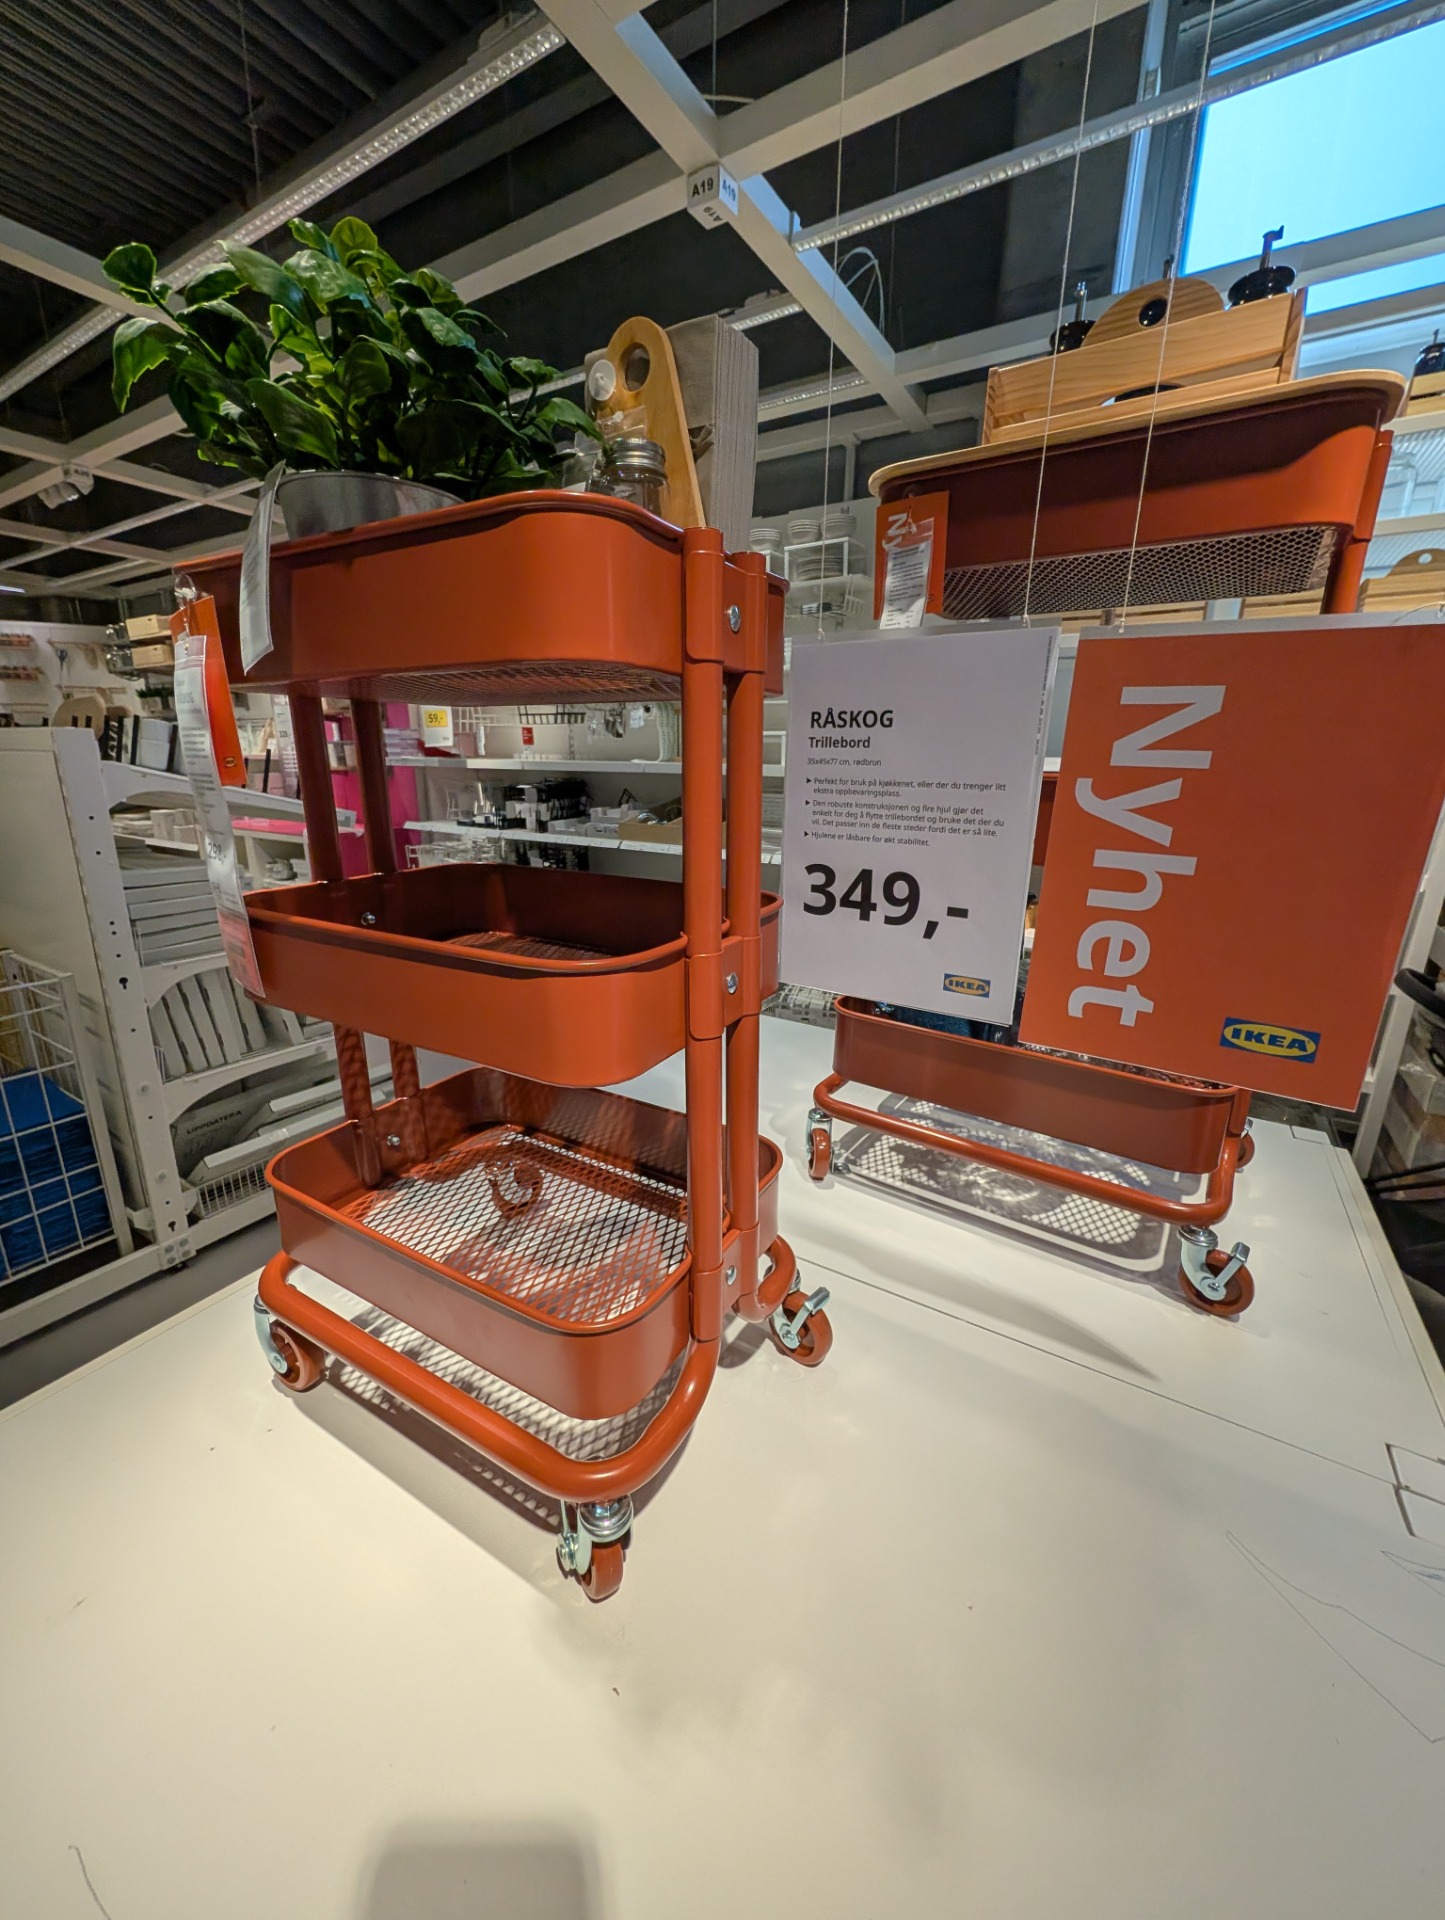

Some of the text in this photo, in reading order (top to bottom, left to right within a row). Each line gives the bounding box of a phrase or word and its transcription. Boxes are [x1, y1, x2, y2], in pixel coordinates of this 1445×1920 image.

[692, 177, 714, 197] A19
[810, 707, 894, 729] RÅSKOG
[808, 736, 871, 748] Trillebord
[807, 757, 882, 767] 35x45x77 cm, rødbrun
[813, 777, 838, 785] Perfekt
[839, 778, 849, 786] for
[868, 779, 877, 789] på
[879, 779, 916, 788] kjøkkenet,
[917, 780, 934, 788] eller
[935, 781, 949, 789] der
[963, 782, 994, 792] trenger
[995, 783, 1007, 791] litt
[813, 787, 902, 798] ekstra oppbevaringsplass.
[828, 801, 854, 809] robuste
[855, 801, 909, 811] konstruksjonen
[911, 805, 920, 813] og
[922, 804, 935, 813] fire
[936, 805, 951, 814] hjul
[952, 807, 968, 816] gjør
[970, 807, 984, 815] det
[845, 811, 858, 820] deg
[866, 812, 884, 820] flytte
[885, 812, 925, 823] trillebordet
[927, 816, 937, 824] og
[939, 816, 961, 824] bruke
[963, 817, 976, 825] det
[978, 818, 992, 826] der
[993, 819, 1004, 827] du
[835, 820, 857, 828] passer
[882, 822, 901, 831] fleste
[903, 823, 926, 832] steder
[928, 825, 946, 833] fordi
[948, 826, 961, 834] det
[972, 828, 981, 836] så
[983, 829, 998, 837] lite.
[811, 831, 836, 840] Hjulene
[846, 833, 871, 842] låsbare
[872, 835, 882, 843] for
[883, 836, 895, 844] økt
[897, 837, 930, 846] stabilitet.
[1067, 685, 1227, 1027] Nyhet
[803, 863, 969, 940] 349,-
[948, 979, 987, 992] IKEA
[1231, 1027, 1308, 1053] IKEA
